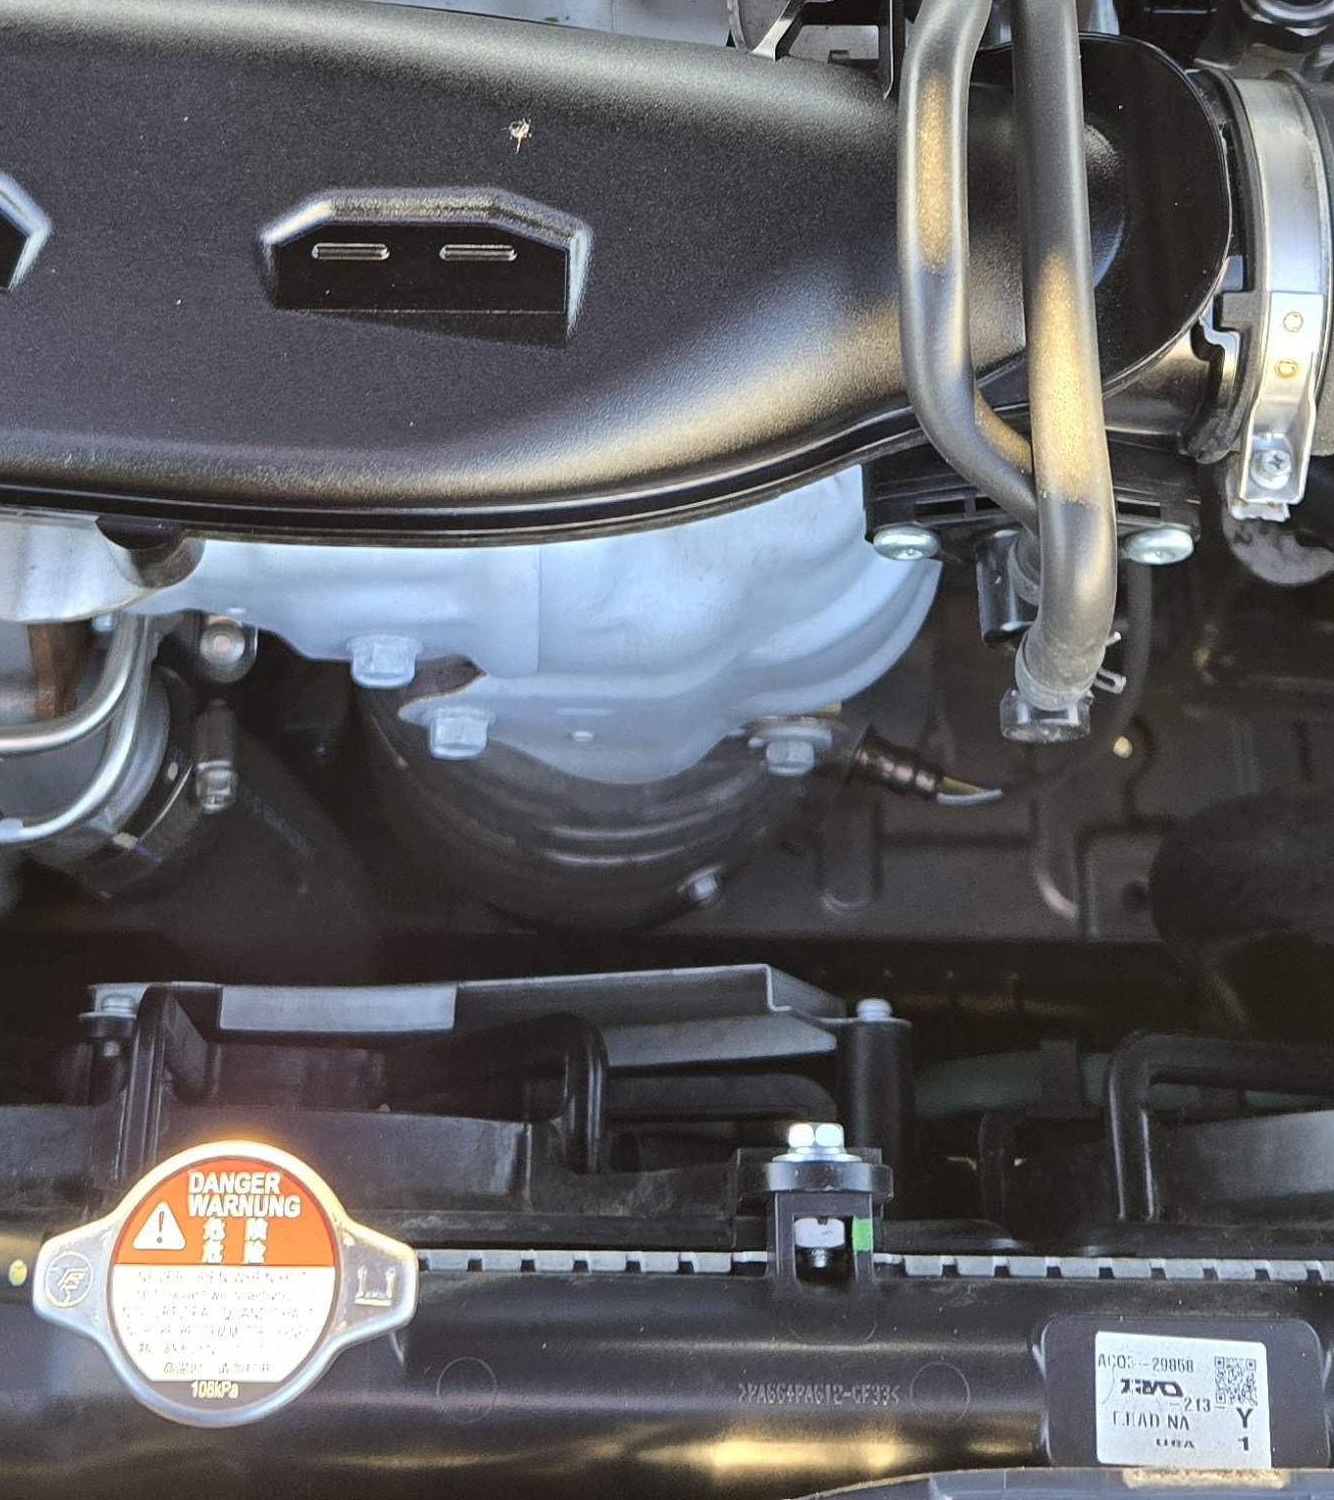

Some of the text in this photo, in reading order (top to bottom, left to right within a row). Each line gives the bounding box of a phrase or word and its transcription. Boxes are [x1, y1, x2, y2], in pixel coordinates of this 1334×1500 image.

[188, 1171, 282, 1195] DANGER
[187, 1193, 301, 1218] WARNUNG
[191, 1380, 239, 1399] 108kPa
[1236, 1407, 1254, 1429] Y
[1238, 1437, 1250, 1451] 1
